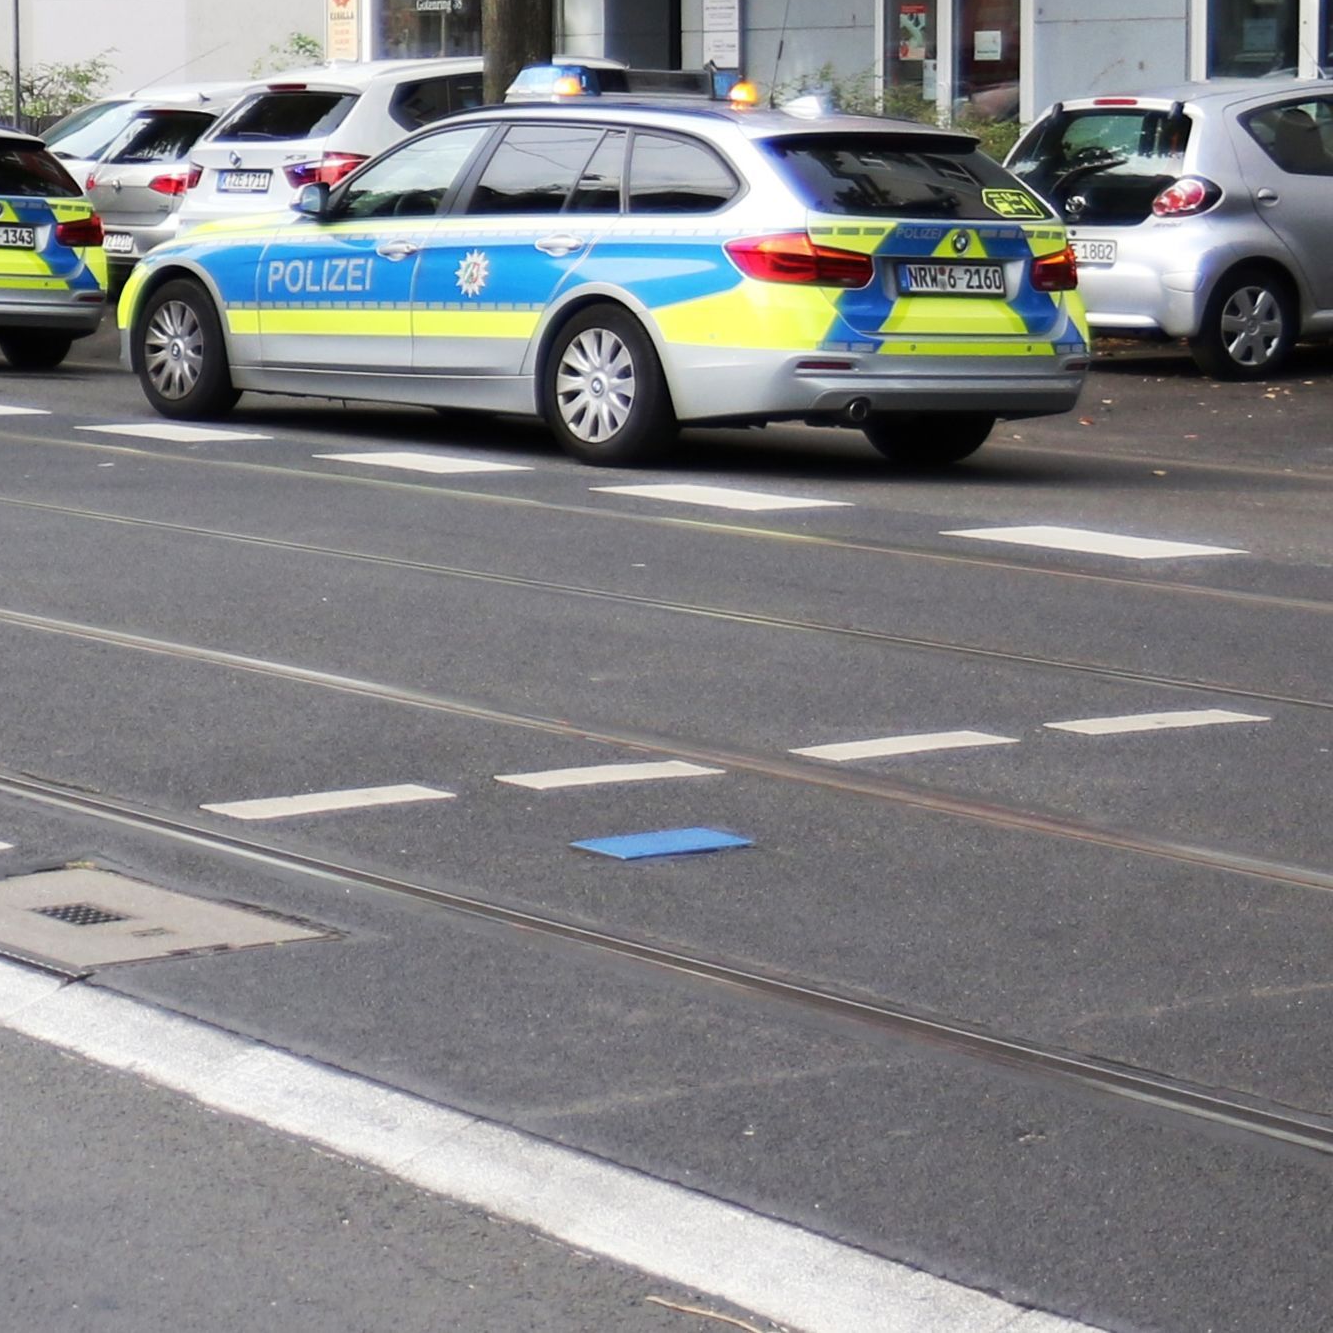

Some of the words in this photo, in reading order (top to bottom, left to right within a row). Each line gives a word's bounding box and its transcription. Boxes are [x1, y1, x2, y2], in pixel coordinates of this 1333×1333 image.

[895, 227, 942, 239] POLIZEI
[267, 258, 374, 293] POLIZEI
[908, 266, 938, 289] NRW
[947, 268, 1002, 290] 6-2160
